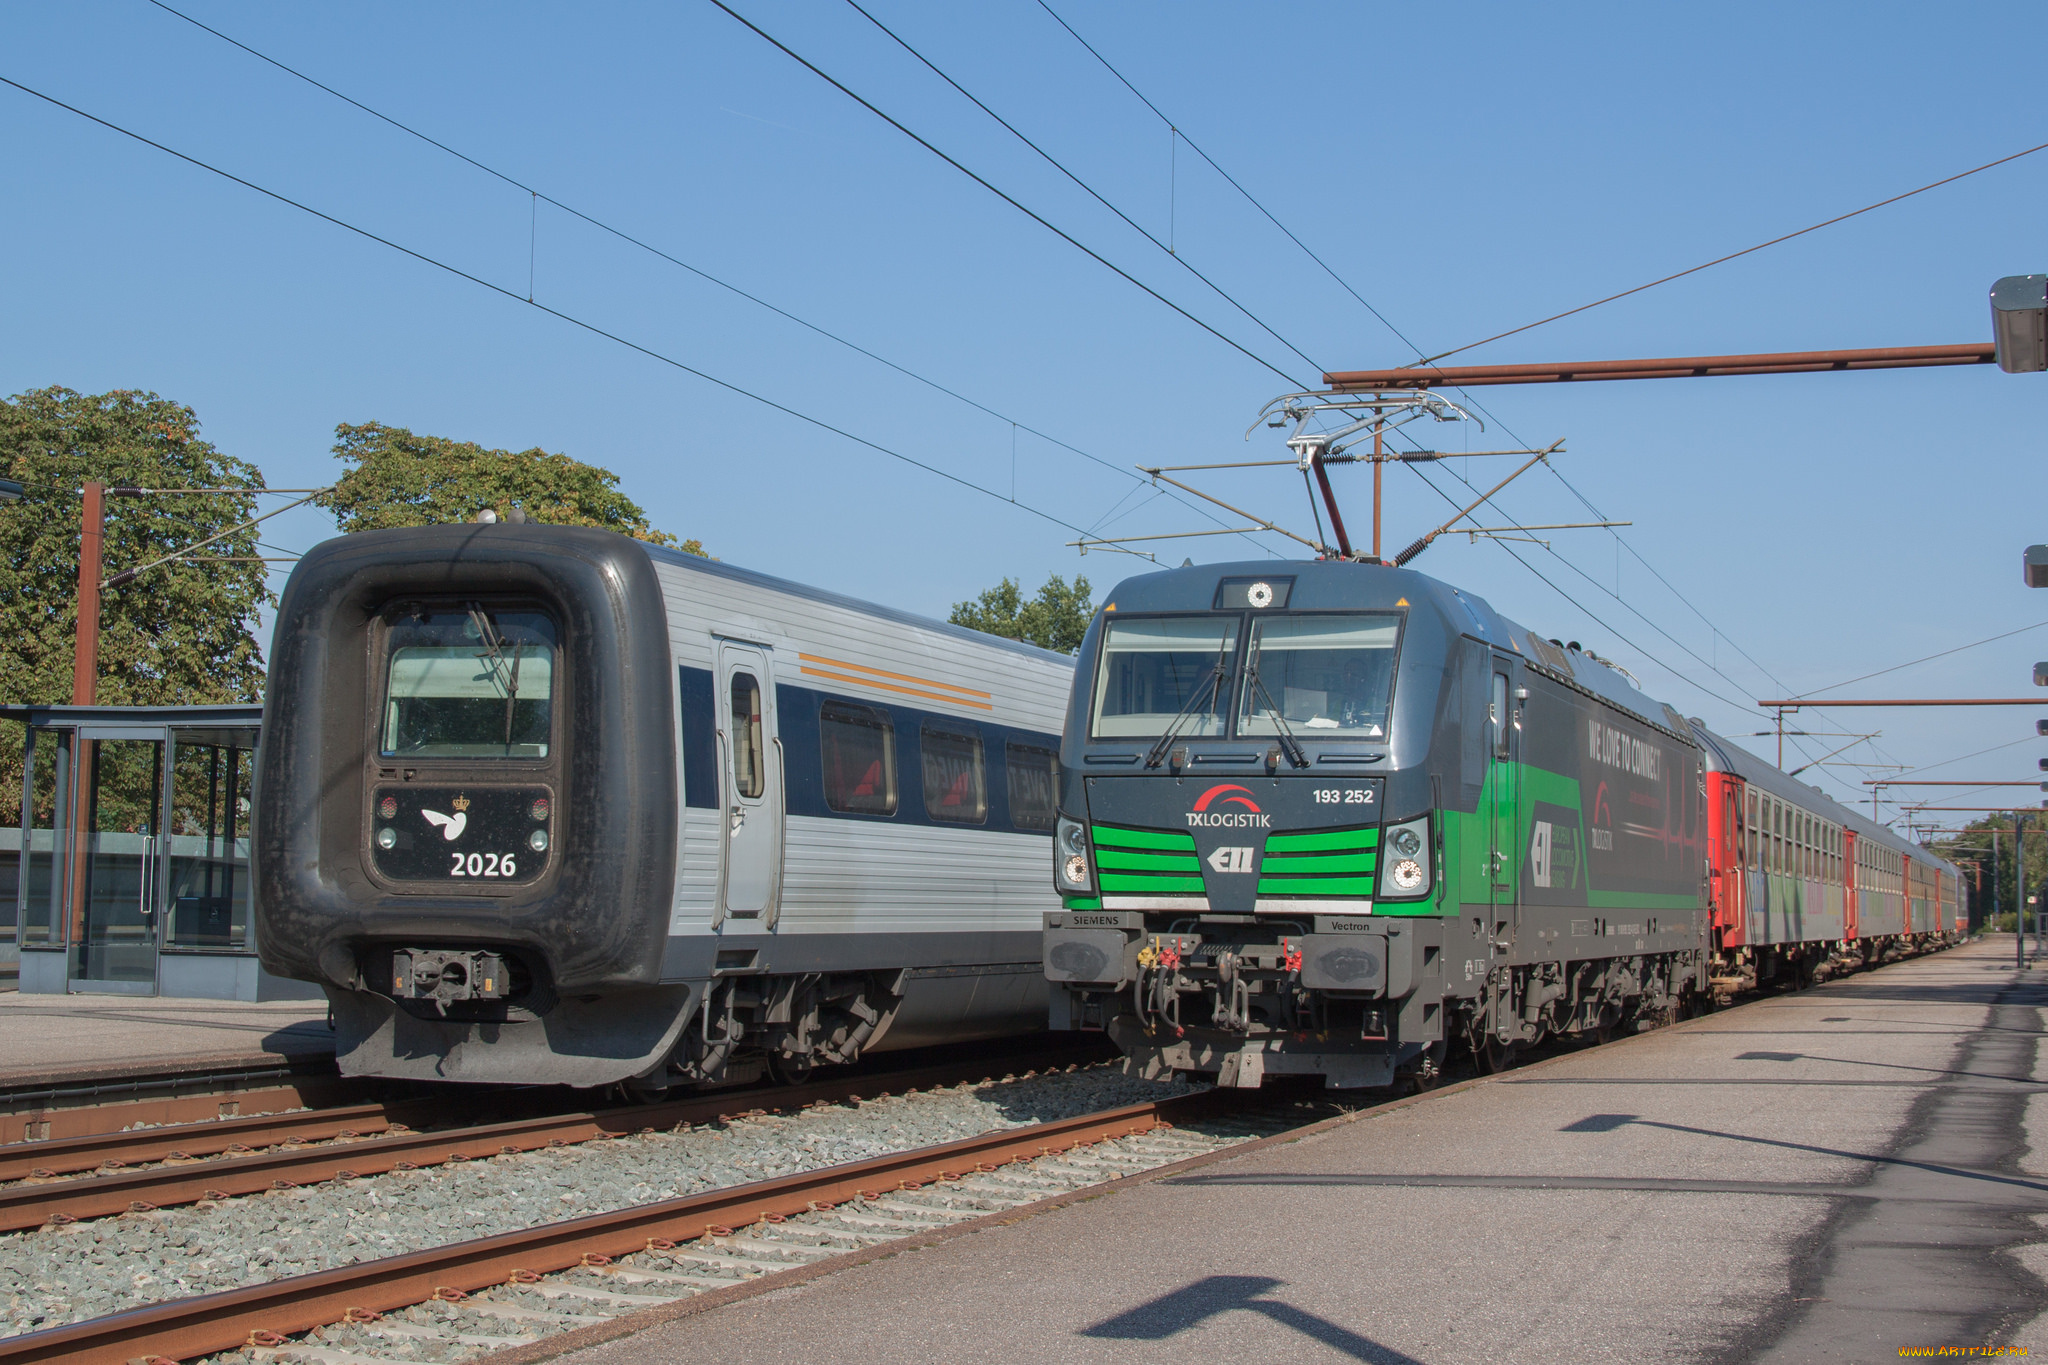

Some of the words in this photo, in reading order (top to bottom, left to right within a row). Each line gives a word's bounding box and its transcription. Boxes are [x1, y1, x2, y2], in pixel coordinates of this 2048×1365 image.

[1588, 719, 1601, 762] WE
[1602, 725, 1620, 768] LOVE
[1621, 733, 1631, 772] TO
[1631, 737, 1661, 782] CONNECT
[1313, 789, 1341, 803] 193
[1344, 790, 1374, 804] 252
[1185, 813, 1271, 828] TXLOGISTIK
[450, 852, 517, 877] 2026
[1073, 916, 1119, 925] SIEMENS
[1331, 921, 1370, 931] Vectron
